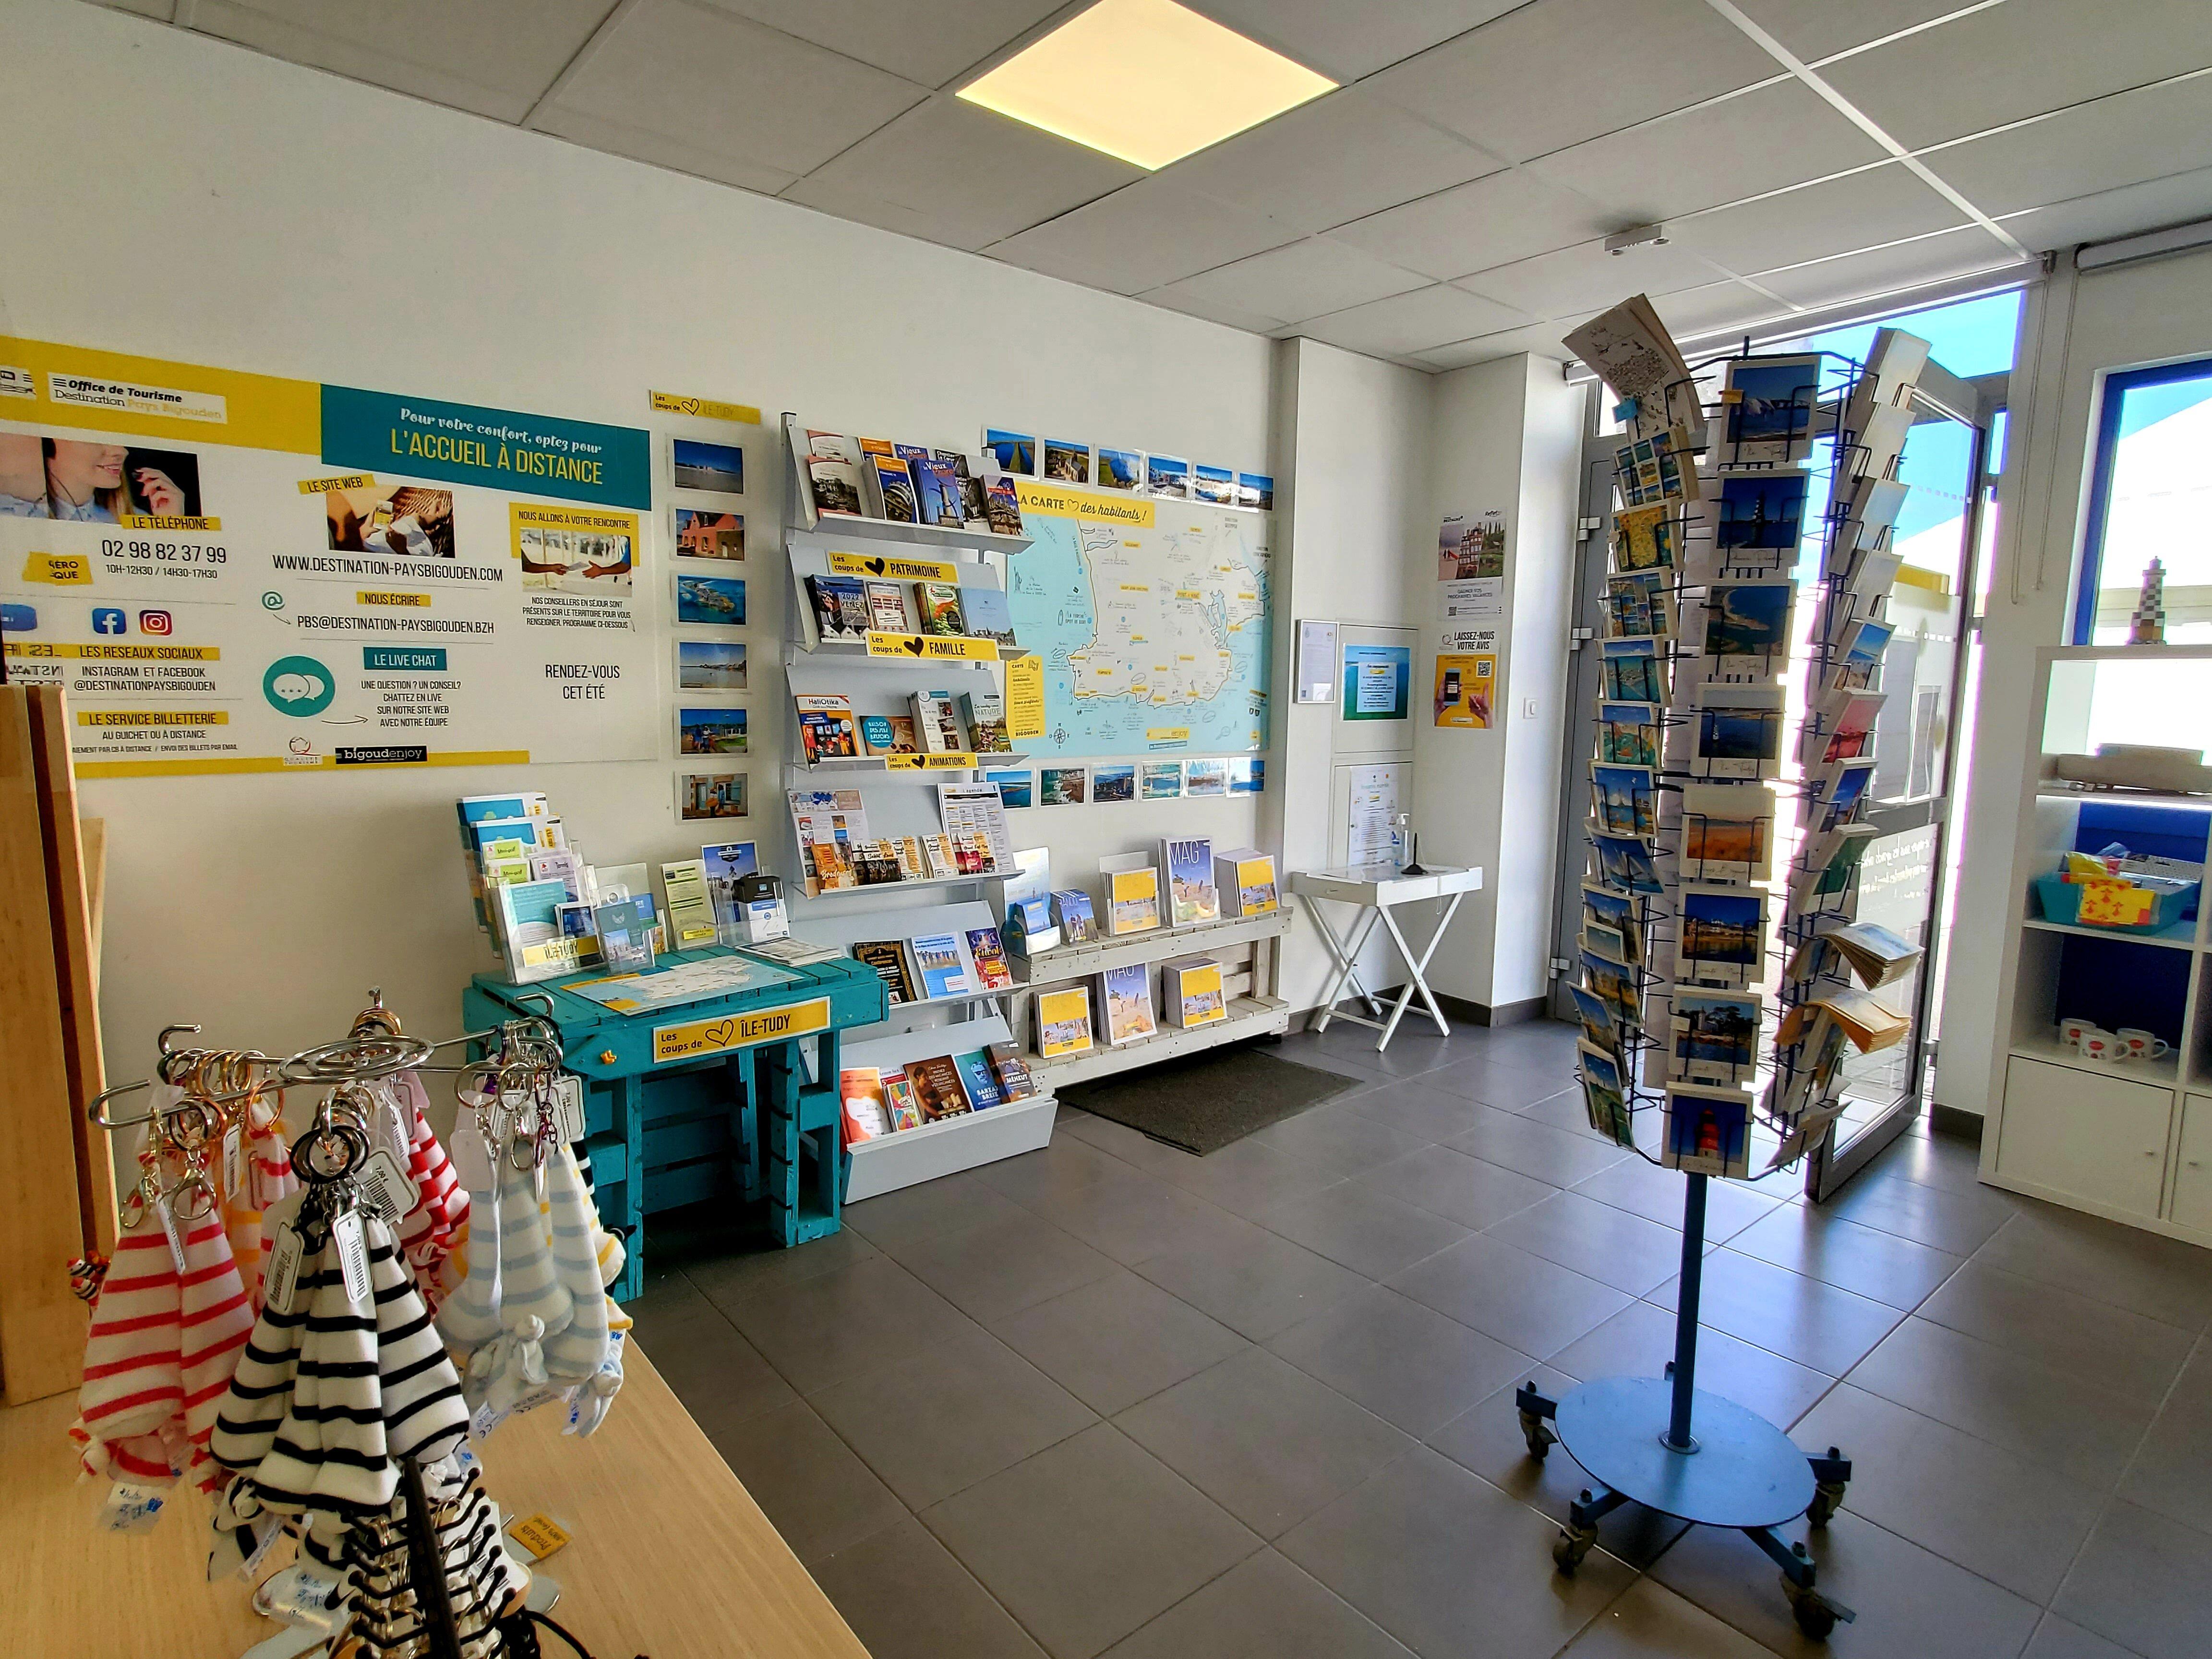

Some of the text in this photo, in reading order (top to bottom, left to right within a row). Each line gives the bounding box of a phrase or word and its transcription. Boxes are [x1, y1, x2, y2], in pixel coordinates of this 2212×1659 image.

[69, 380, 182, 402] Office de Tourisme
[54, 389, 125, 407] Destination
[400, 408, 602, 455] Pour votre confort, optez pour
[391, 429, 602, 485] L'ACCUEIL À DISTANCE
[926, 462, 947, 470] Vieux
[307, 477, 363, 492] LE SITE WEB
[1031, 497, 1065, 510] CARTE
[1080, 503, 1096, 515] des
[1098, 504, 1141, 522] habitants
[1142, 510, 1147, 521] !
[132, 517, 209, 530] LE TÉLÉPHONE
[518, 511, 536, 521] NOUS
[538, 512, 563, 523] ALLONS
[572, 515, 592, 526] VOTRE
[593, 517, 630, 529] RENCONTRE
[102, 540, 226, 563] 02 98 82 37 99
[833, 555, 845, 563] Les
[106, 565, 152, 577] 10H-12H30
[163, 566, 217, 579] 14H30-17H30
[273, 554, 503, 582] WWW.DESTINATION-PAYSBIGOUDEN.COM
[834, 564, 854, 573] coups
[890, 563, 941, 578] PATRIMOINE
[50, 570, 79, 580] QUE
[365, 593, 421, 606] NOUS ÉCRIRE
[532, 597, 623, 608] NOS CONSEILLERS EN SÉJOUR SONT
[523, 606, 631, 618] PRÉSENTS SUR LE TERRITOIRE POUR VOUS
[297, 614, 494, 634] PBS@DESTINATION-PAYSBIGOUDEN.BZH
[562, 619, 596, 628] PROGRAMME
[597, 620, 628, 629] CI-DESSOUS
[1455, 631, 1494, 640] LAISSEZ-NOUS
[873, 645, 892, 654] coups
[929, 642, 966, 656] FAMILLE
[1457, 641, 1490, 650] VOTRE AVIS
[80, 646, 204, 660] LES RESEAUX SOCIAUX
[374, 654, 437, 667] LE LIVE CHAT
[82, 666, 205, 678] INSTAGRAM ET FACEBOOK
[546, 664, 620, 679] RENDEZ-VOUS
[74, 681, 216, 692] @DESTINATIONPAYSBIGOUDEN
[361, 681, 461, 690] UNE QUESTION ? UN CONSEIL?
[563, 684, 605, 699] CET ÉTÉ
[384, 693, 442, 702] CHATTEZ EN LIVE
[377, 706, 449, 715] SUR NOTRE SITE WEB
[89, 713, 216, 725] LE SERVICE BILLETTERIE
[380, 716, 448, 727] AVEC NOTRE ÉQUIPE
[103, 729, 206, 739] AU GUICHET OU À DISTANCE
[344, 747, 422, 760] bigoudenjoy
[929, 756, 966, 767] ANIMATIONS
[1170, 840, 1199, 865] MAG
[661, 1014, 791, 1055] coups de ÎLE-TUDY
[661, 1032, 677, 1042] Les
[374, 1166, 386, 1179] 7,00
